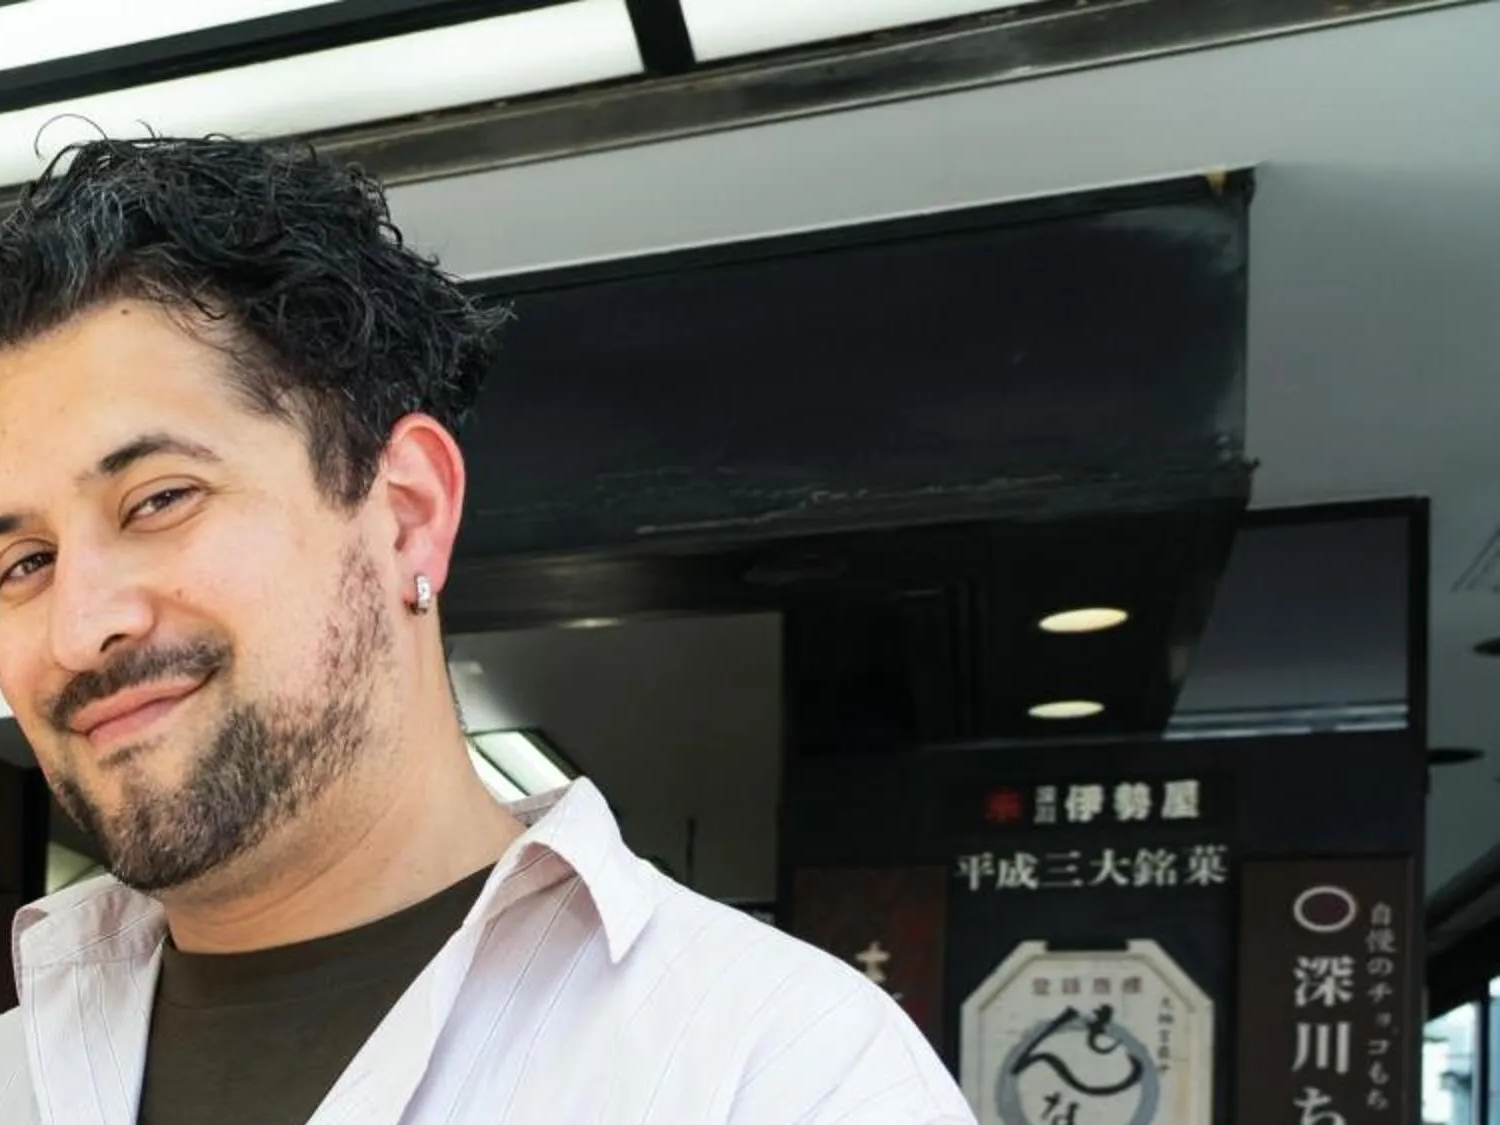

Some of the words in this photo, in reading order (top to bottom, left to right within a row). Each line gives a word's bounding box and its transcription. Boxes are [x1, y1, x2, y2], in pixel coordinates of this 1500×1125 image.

[1064, 778, 1200, 823] 伊勢屋
[954, 844, 1228, 891] 平成三大銘菓
